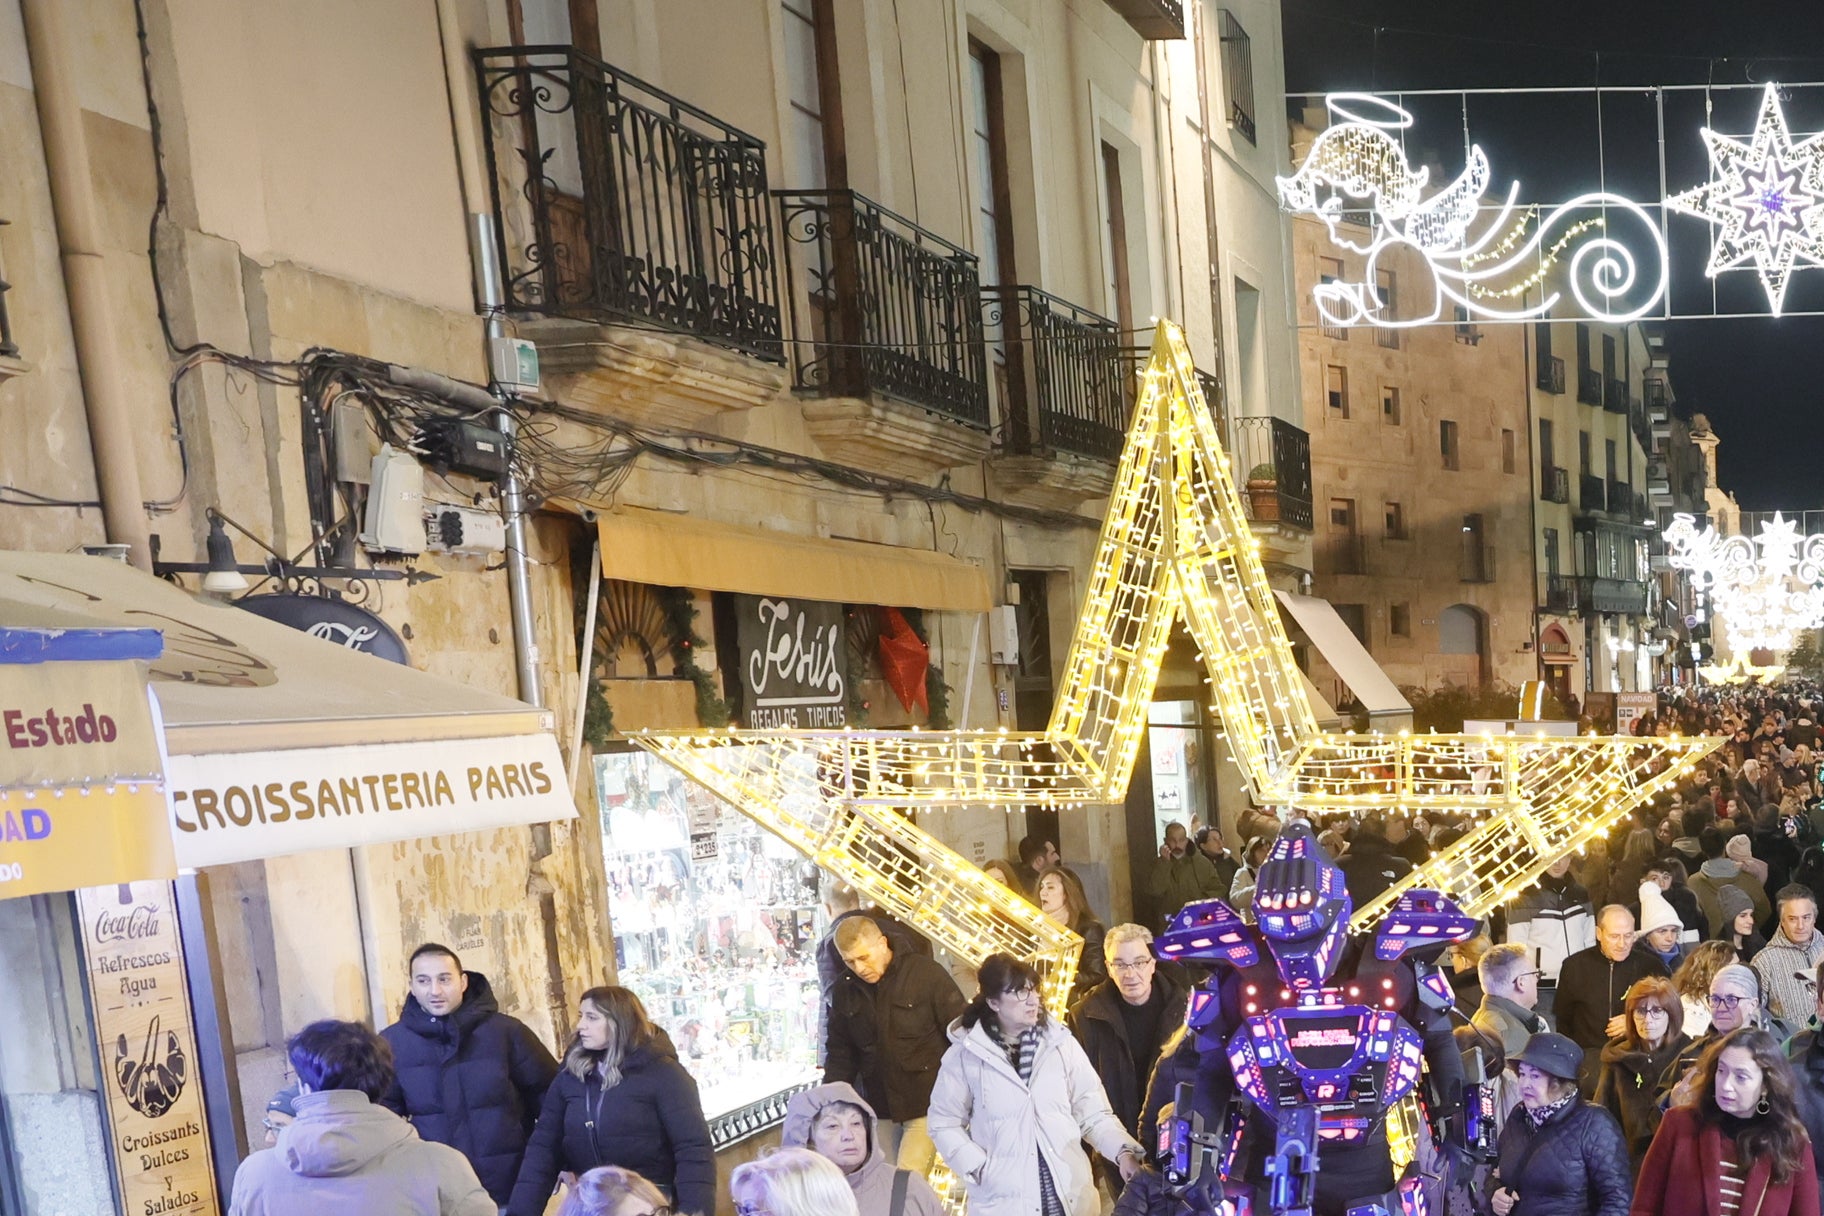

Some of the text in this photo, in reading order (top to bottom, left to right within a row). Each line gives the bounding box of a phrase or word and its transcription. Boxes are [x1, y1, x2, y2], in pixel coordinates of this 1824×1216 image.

[749, 598, 843, 703] Jesús
[1620, 695, 1653, 703] NAVIDAD
[3, 703, 117, 748] Estado
[751, 705, 845, 730] REGALOS TIPICOS
[173, 761, 552, 833] CROISSANTERIA PARIS
[0, 808, 52, 842] AD
[98, 951, 171, 974] Refrescos
[120, 976, 157, 997] Agua
[122, 1121, 200, 1152] Croissants
[140, 1148, 189, 1171] Dulces
[164, 1175, 173, 1191] y
[143, 1190, 199, 1216] Salados
